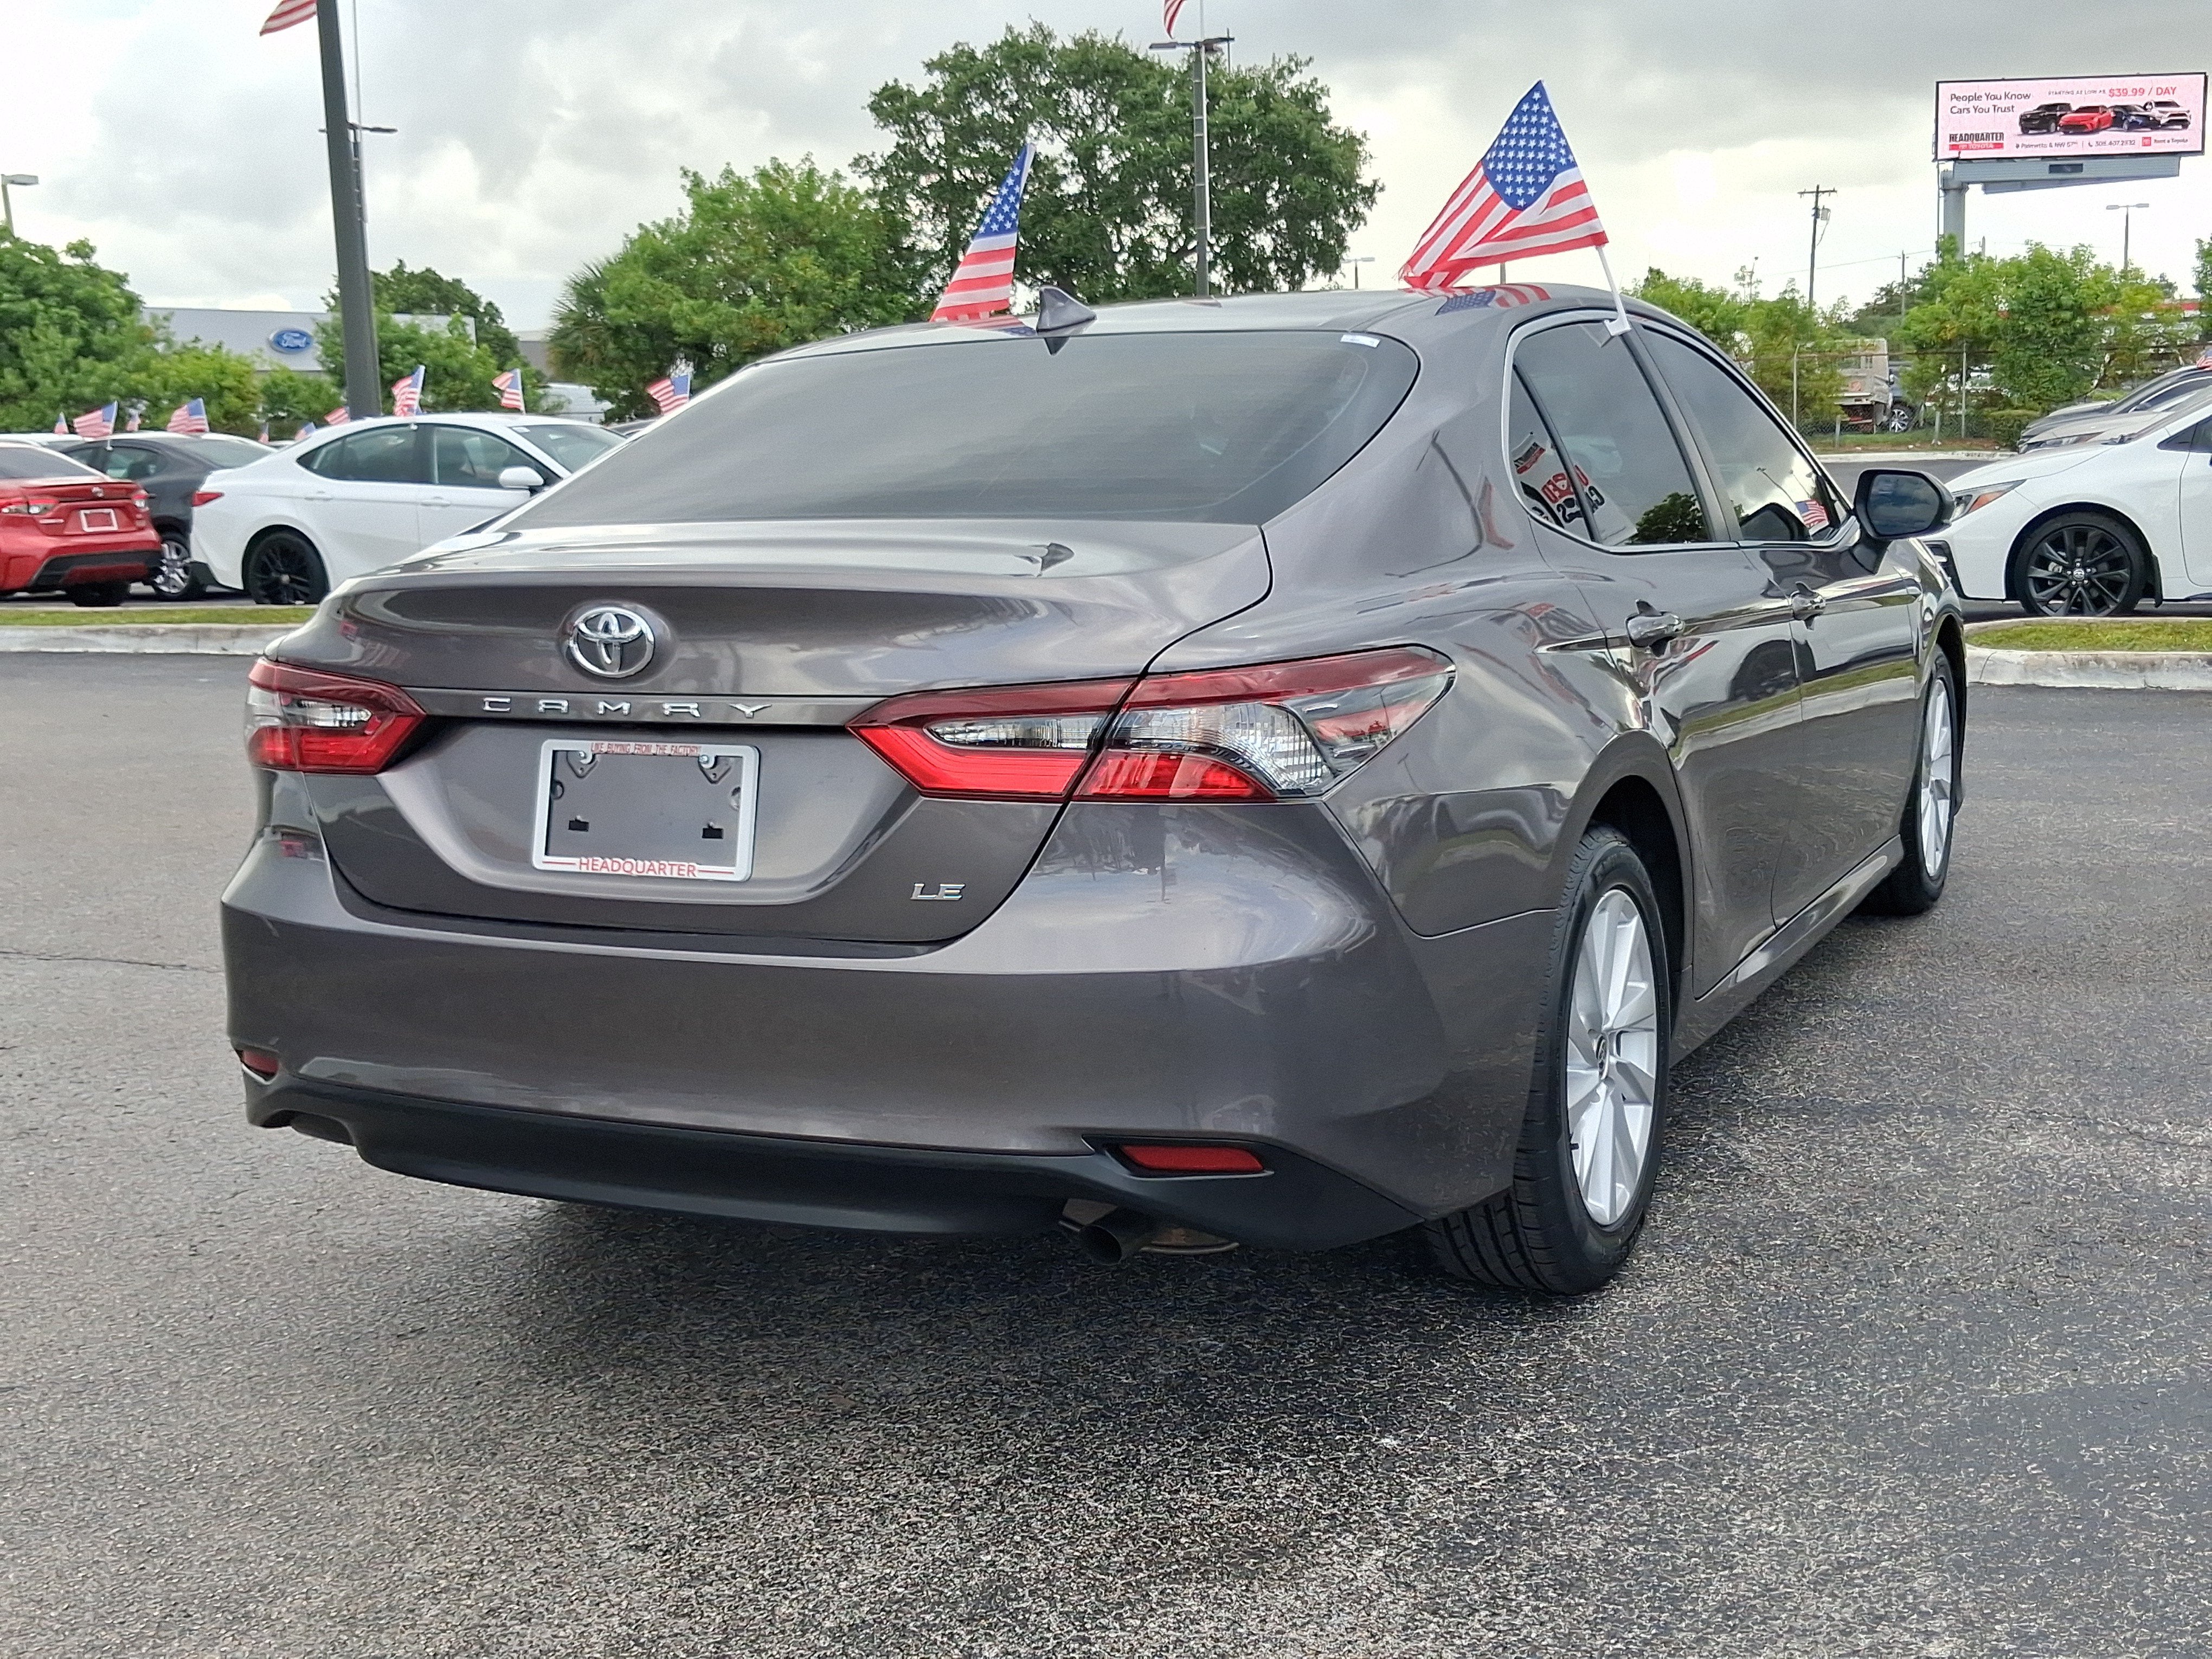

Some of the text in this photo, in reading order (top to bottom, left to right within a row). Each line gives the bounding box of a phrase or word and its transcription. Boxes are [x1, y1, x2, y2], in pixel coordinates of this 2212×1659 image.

[1950, 91, 2031, 104] People You Know
[2108, 87, 2145, 98] $39.99
[2156, 87, 2177, 96] DAY
[1950, 104, 2015, 114] Cars You Trust
[1949, 132, 2004, 143] HEADQUARTER
[281, 332, 307, 348] Ford
[482, 696, 772, 718] CAMRY
[608, 743, 631, 754] BUYING
[634, 743, 653, 754] FROM
[656, 744, 668, 755] THE
[578, 858, 697, 877] HEADQUARTER
[910, 883, 966, 901] LE
